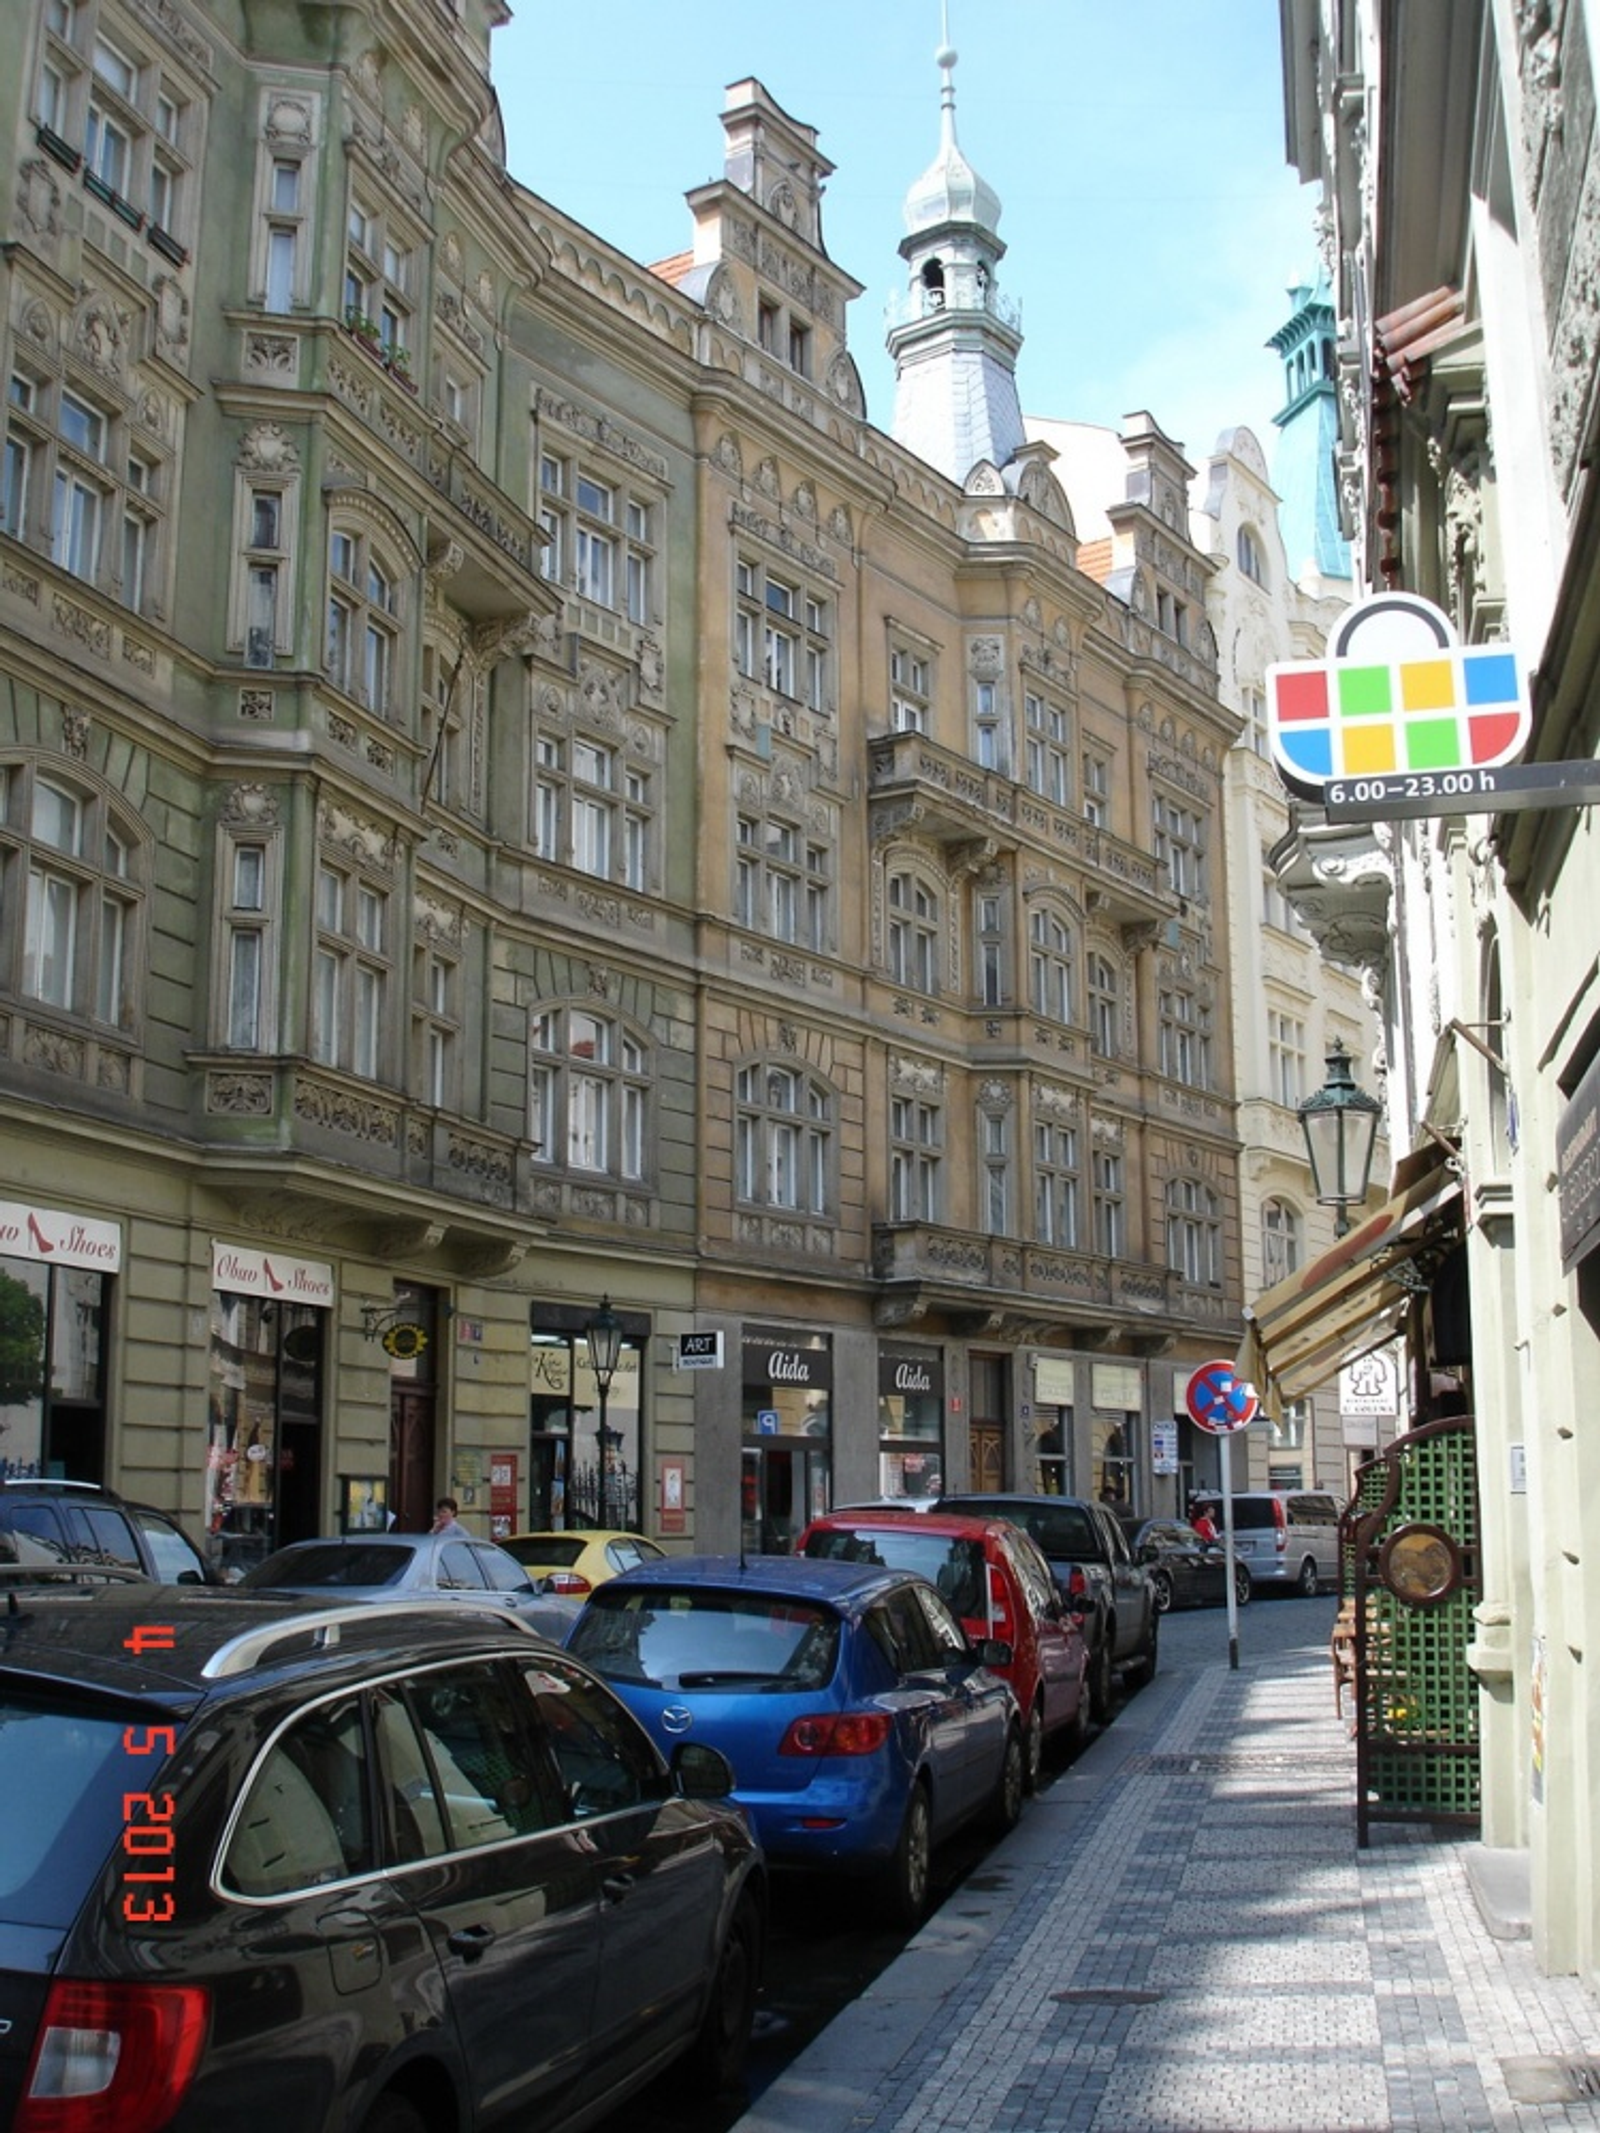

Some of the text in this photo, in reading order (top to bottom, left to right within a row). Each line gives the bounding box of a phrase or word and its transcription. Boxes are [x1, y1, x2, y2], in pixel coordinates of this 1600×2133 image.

[1479, 770, 1495, 791] h
[60, 1224, 117, 1260] Shoes
[287, 1267, 330, 1296] Shoes
[684, 1336, 713, 1354] ART
[767, 1350, 810, 1382] Aida
[895, 1363, 931, 1391] Aida
